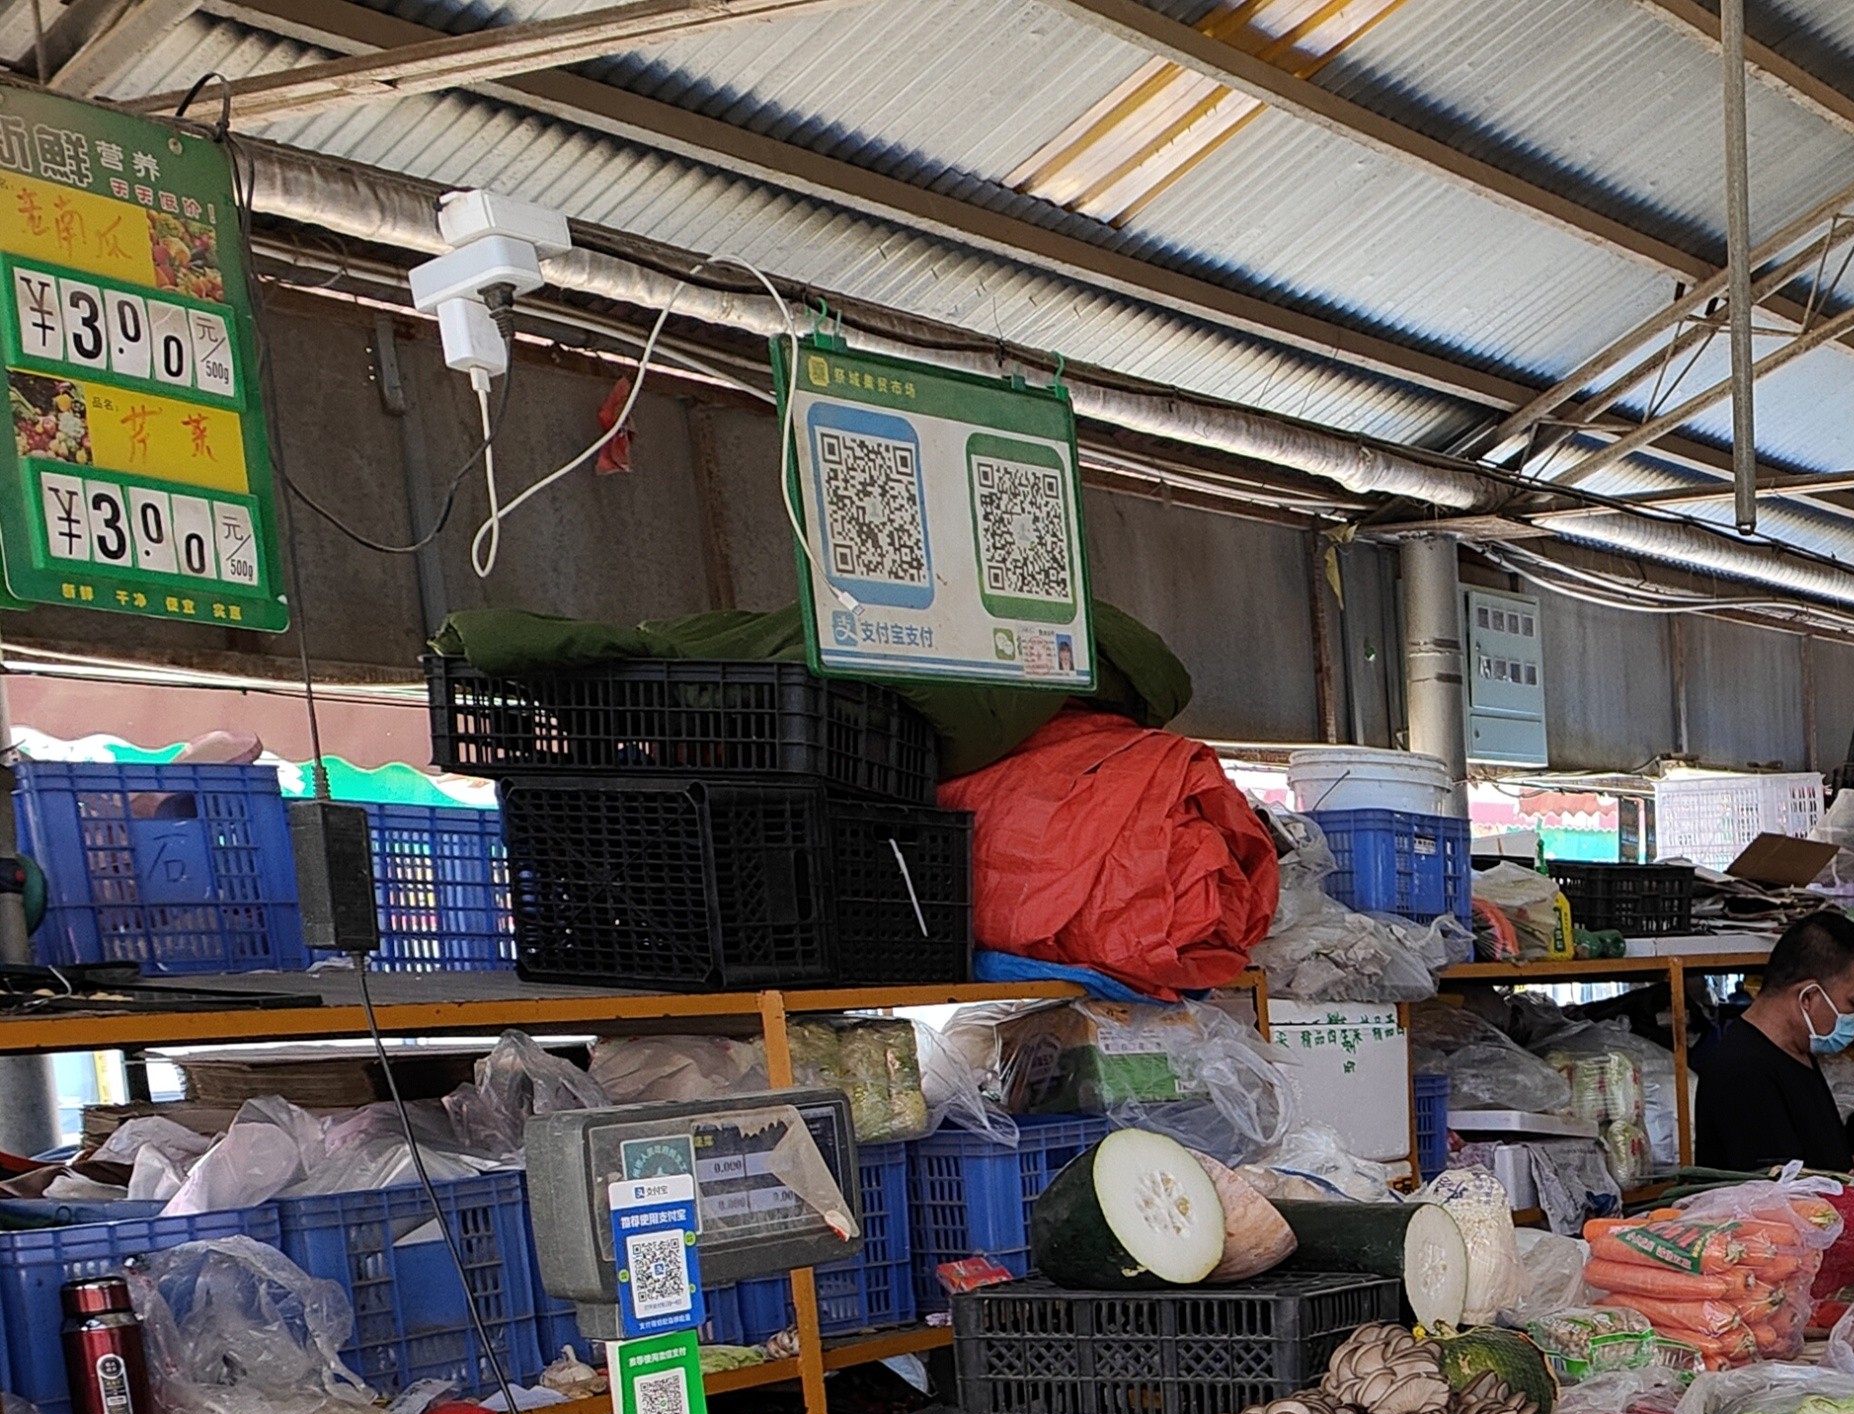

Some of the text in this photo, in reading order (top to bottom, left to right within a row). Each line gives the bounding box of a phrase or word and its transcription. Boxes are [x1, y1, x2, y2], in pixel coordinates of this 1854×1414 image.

[95, 140, 161, 182] 营养
[116, 589, 147, 608] 干净
[860, 620, 934, 649] 支付宝支付
[646, 1185, 669, 1197] 支付宝
[620, 1208, 687, 1230] 推荐使用支付宝
